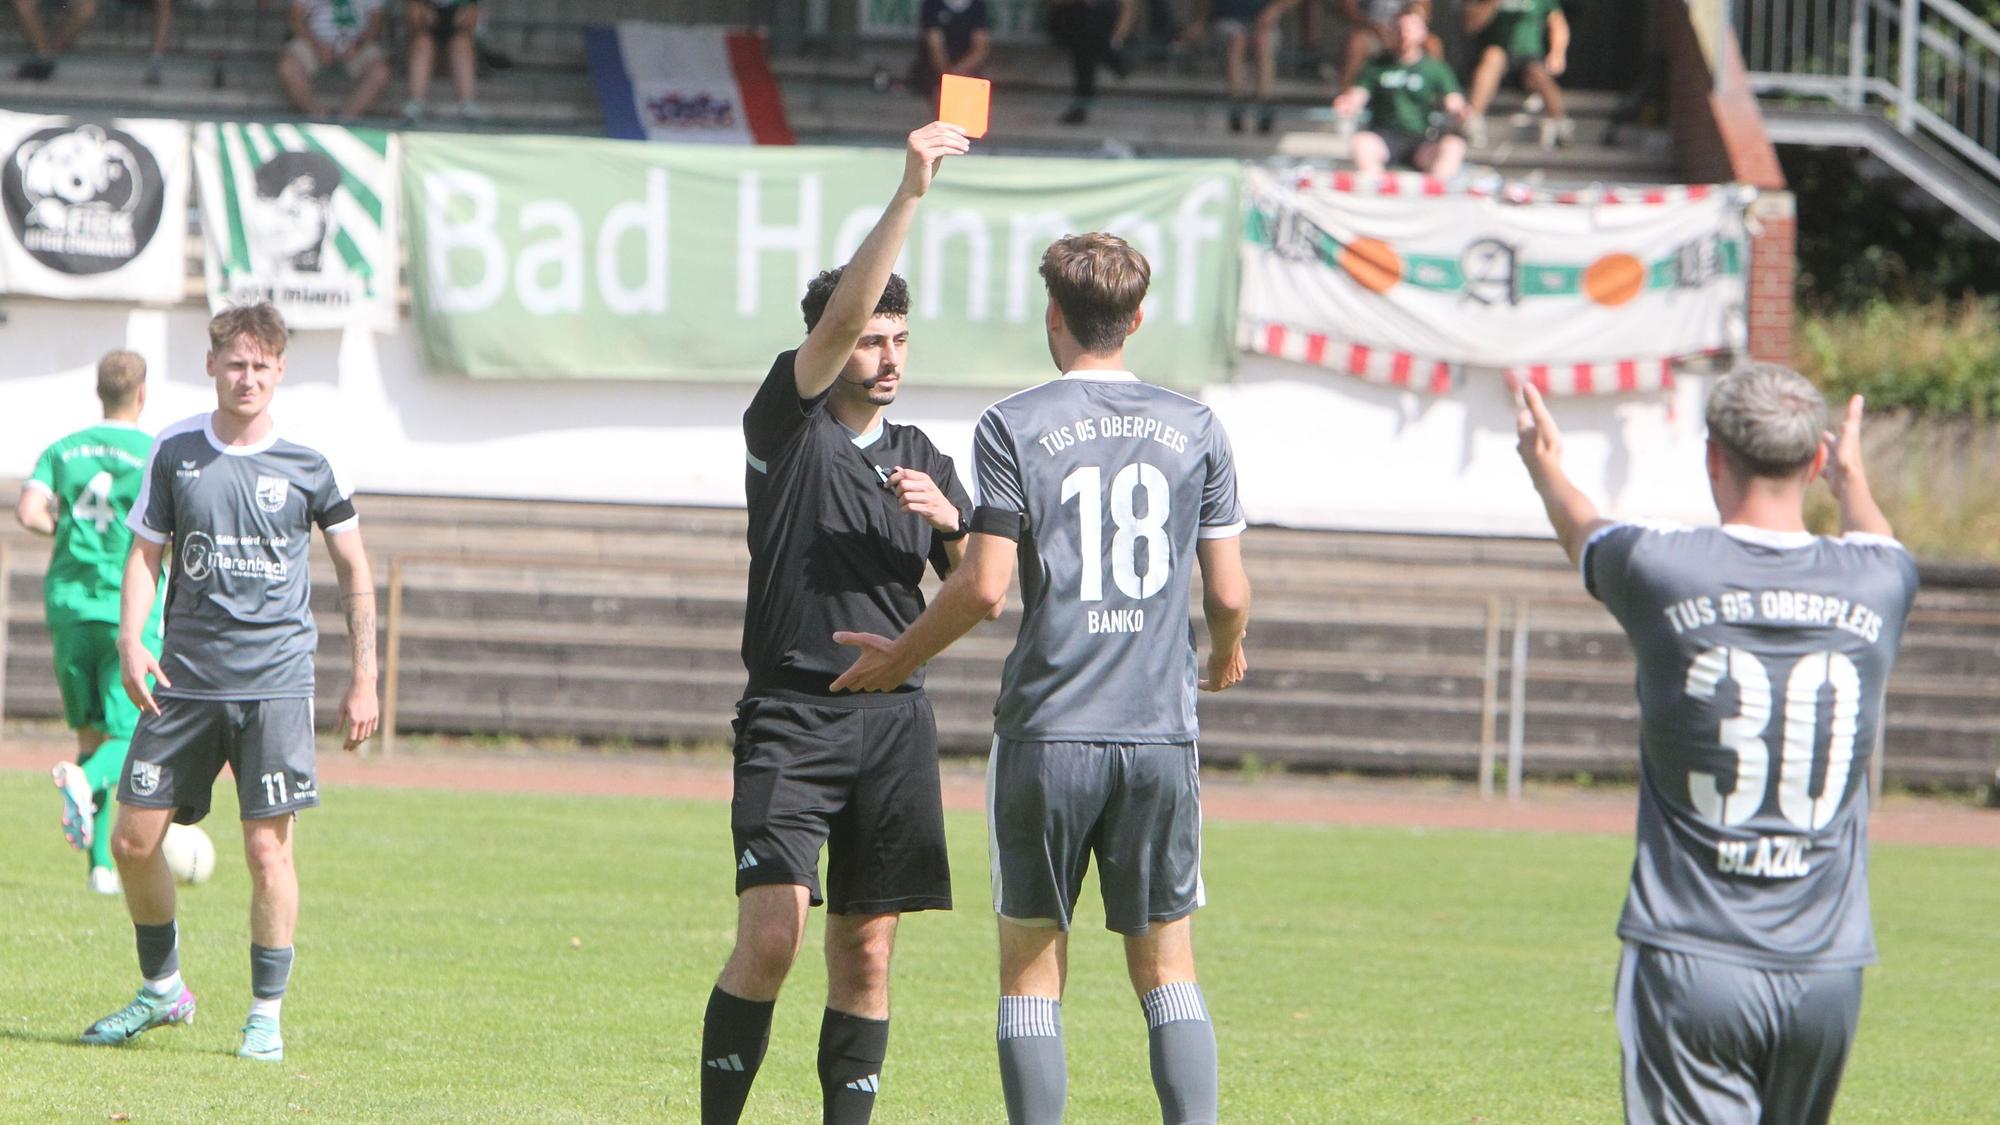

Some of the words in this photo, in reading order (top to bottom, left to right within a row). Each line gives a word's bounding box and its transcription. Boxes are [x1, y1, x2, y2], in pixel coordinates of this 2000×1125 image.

[423, 167, 669, 314] Bad
[1039, 426, 1075, 456] TUS
[1075, 418, 1097, 442] 05
[1100, 416, 1188, 454] OBERPLEIS
[72, 471, 114, 533] 4
[1060, 462, 1171, 602] 18
[1088, 609, 1144, 634] BANKO
[1664, 596, 1717, 635] TUS
[1720, 591, 1754, 622] 05
[1760, 590, 1882, 644] OBERPLEIS
[1685, 646, 1861, 831] 30
[261, 772, 288, 806] 11
